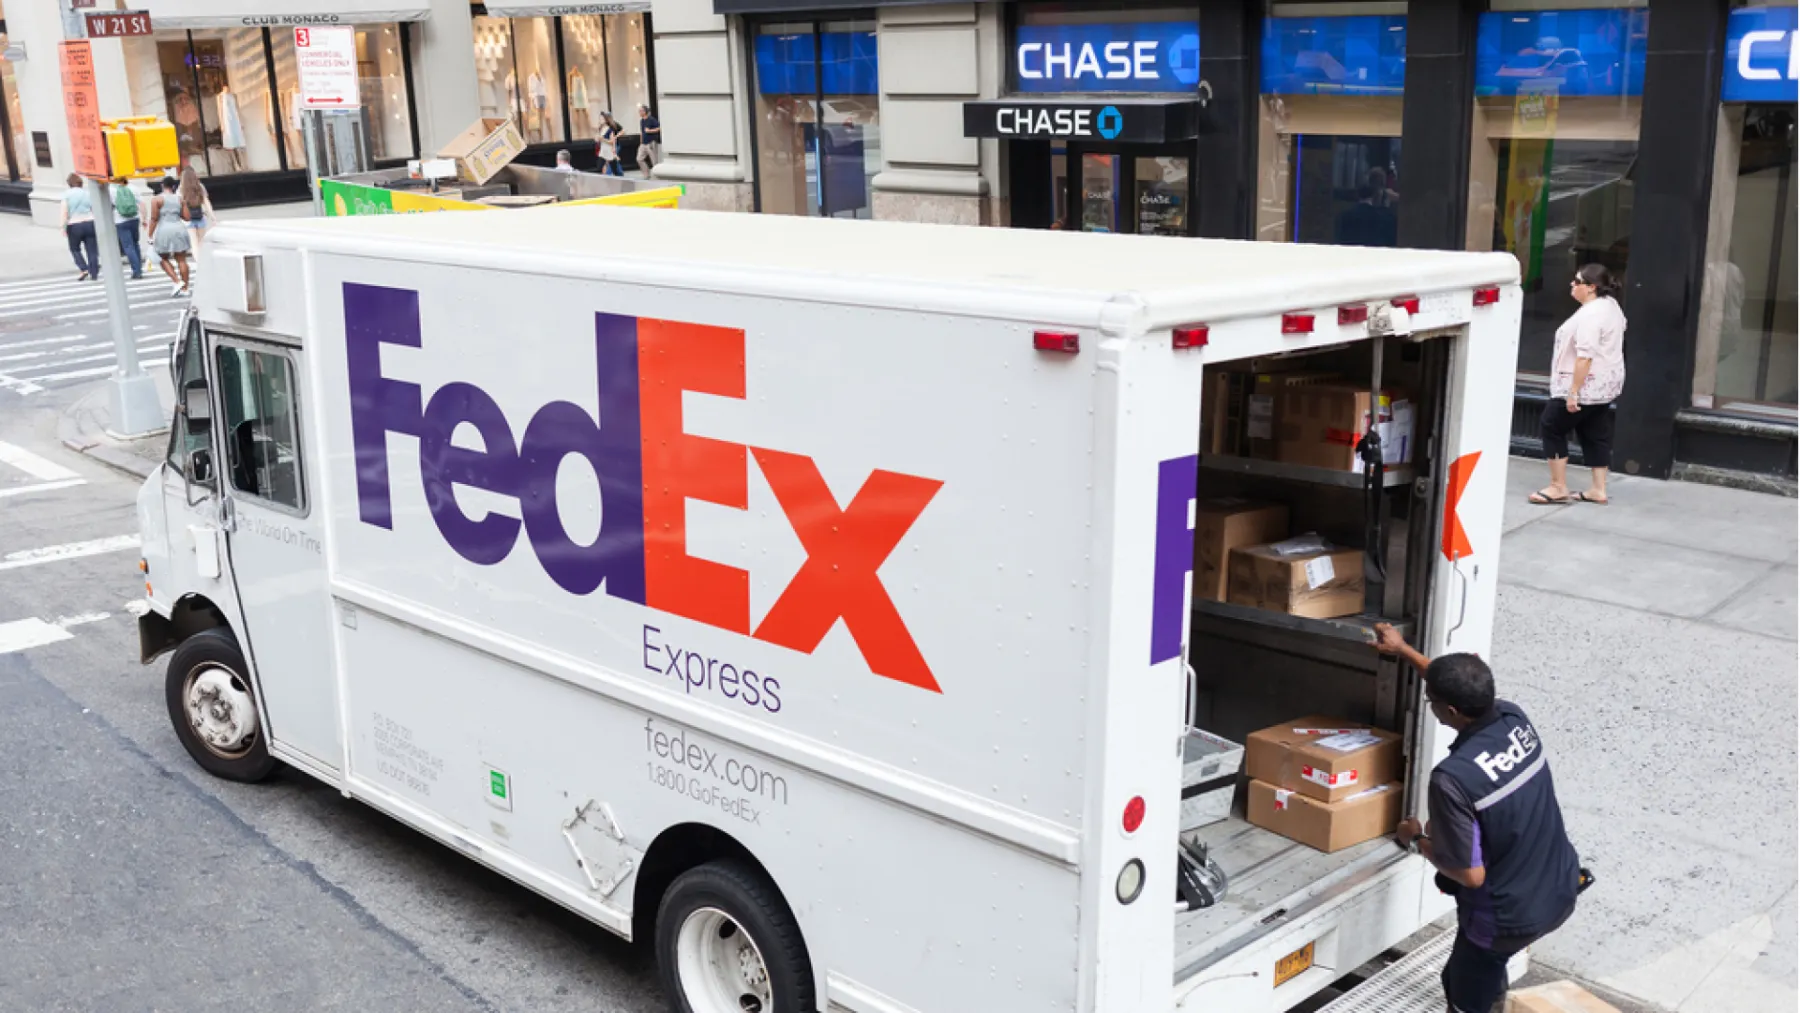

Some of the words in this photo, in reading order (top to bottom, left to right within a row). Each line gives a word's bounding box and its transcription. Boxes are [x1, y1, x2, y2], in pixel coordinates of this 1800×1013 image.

[242, 16, 279, 25] CLUB
[283, 14, 339, 24] MONACO
[548, 7, 578, 15] CLUB
[580, 5, 626, 13] MONACO
[92, 19, 107, 35] W
[111, 17, 127, 34] 21
[131, 16, 148, 33] St
[299, 29, 308, 46] 3
[1018, 41, 1160, 79] CHASE
[996, 108, 1092, 136] CHASE
[1140, 195, 1170, 204] CHASE
[342, 281, 946, 694] FedEx
[300, 530, 322, 555] Time
[643, 624, 782, 713] Express
[644, 718, 788, 805] fedex.com
